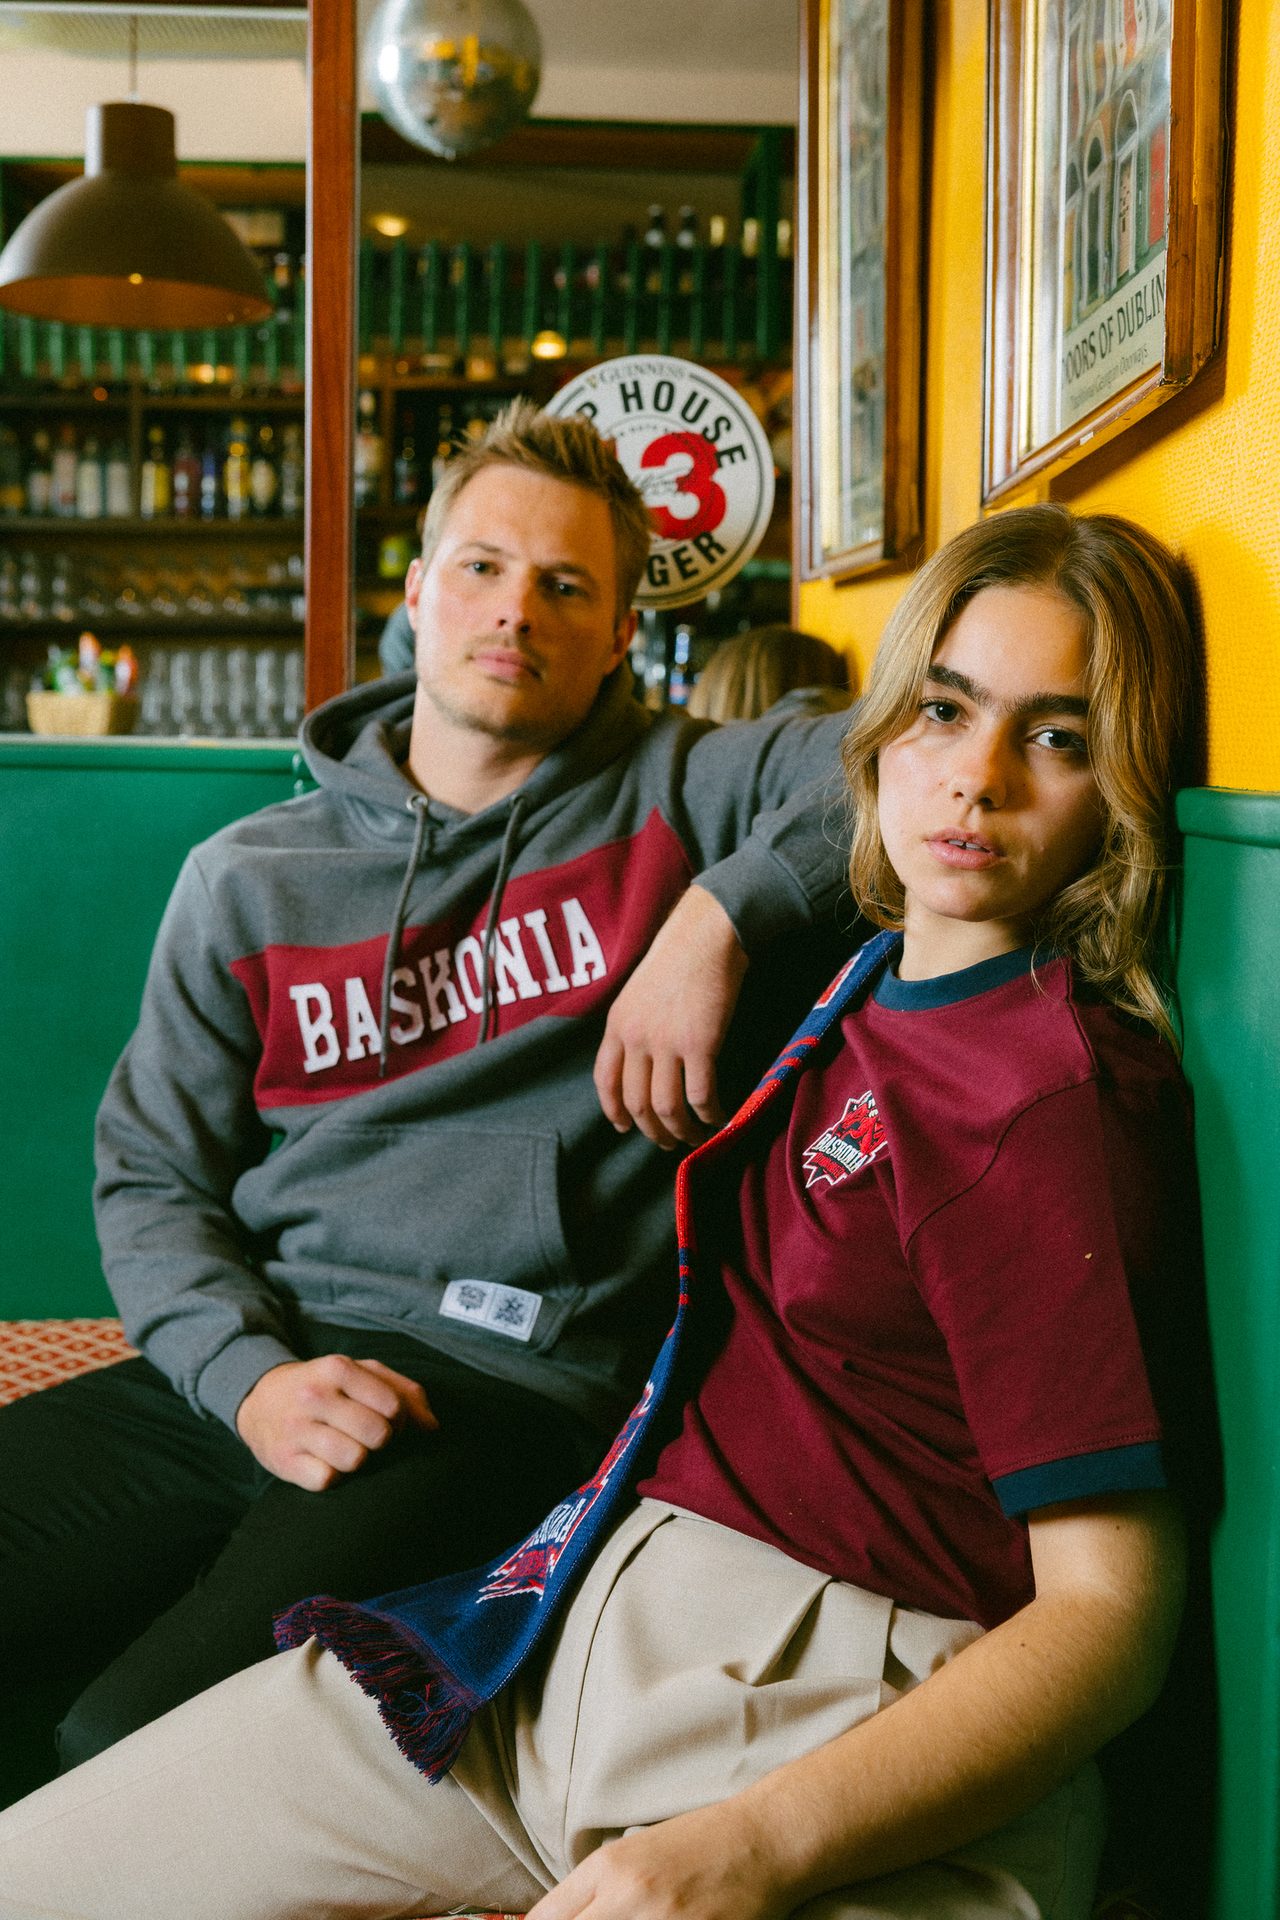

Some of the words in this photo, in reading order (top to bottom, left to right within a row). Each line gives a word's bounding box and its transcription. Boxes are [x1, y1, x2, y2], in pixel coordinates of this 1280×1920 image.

[1062, 331, 1097, 384] OORS
[1099, 315, 1114, 359] OF
[1116, 269, 1166, 345] DUBLIN
[619, 379, 747, 469] HOUSE
[288, 897, 608, 1075] BASKONIA
